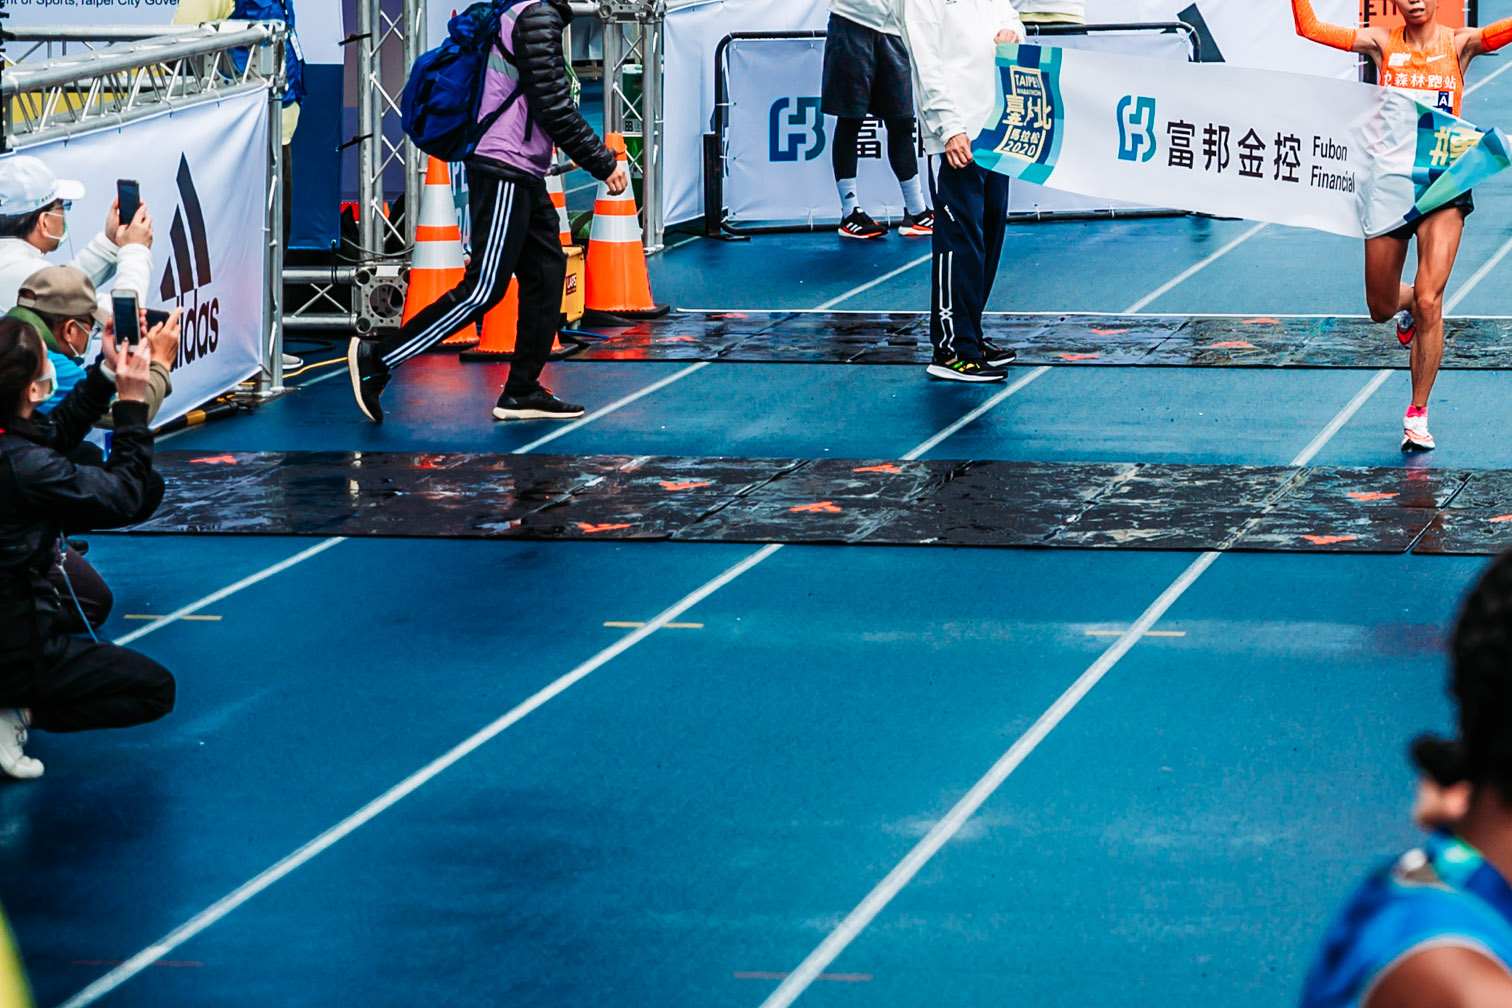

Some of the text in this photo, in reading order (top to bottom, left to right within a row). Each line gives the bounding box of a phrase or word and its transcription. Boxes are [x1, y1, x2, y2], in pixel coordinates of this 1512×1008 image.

[1015, 74, 1040, 88] TAIPEI
[1003, 141, 1036, 156] 2020
[1166, 119, 1301, 183] 富邦金控
[1312, 135, 1348, 162] Fubon
[1310, 164, 1356, 195] Financial
